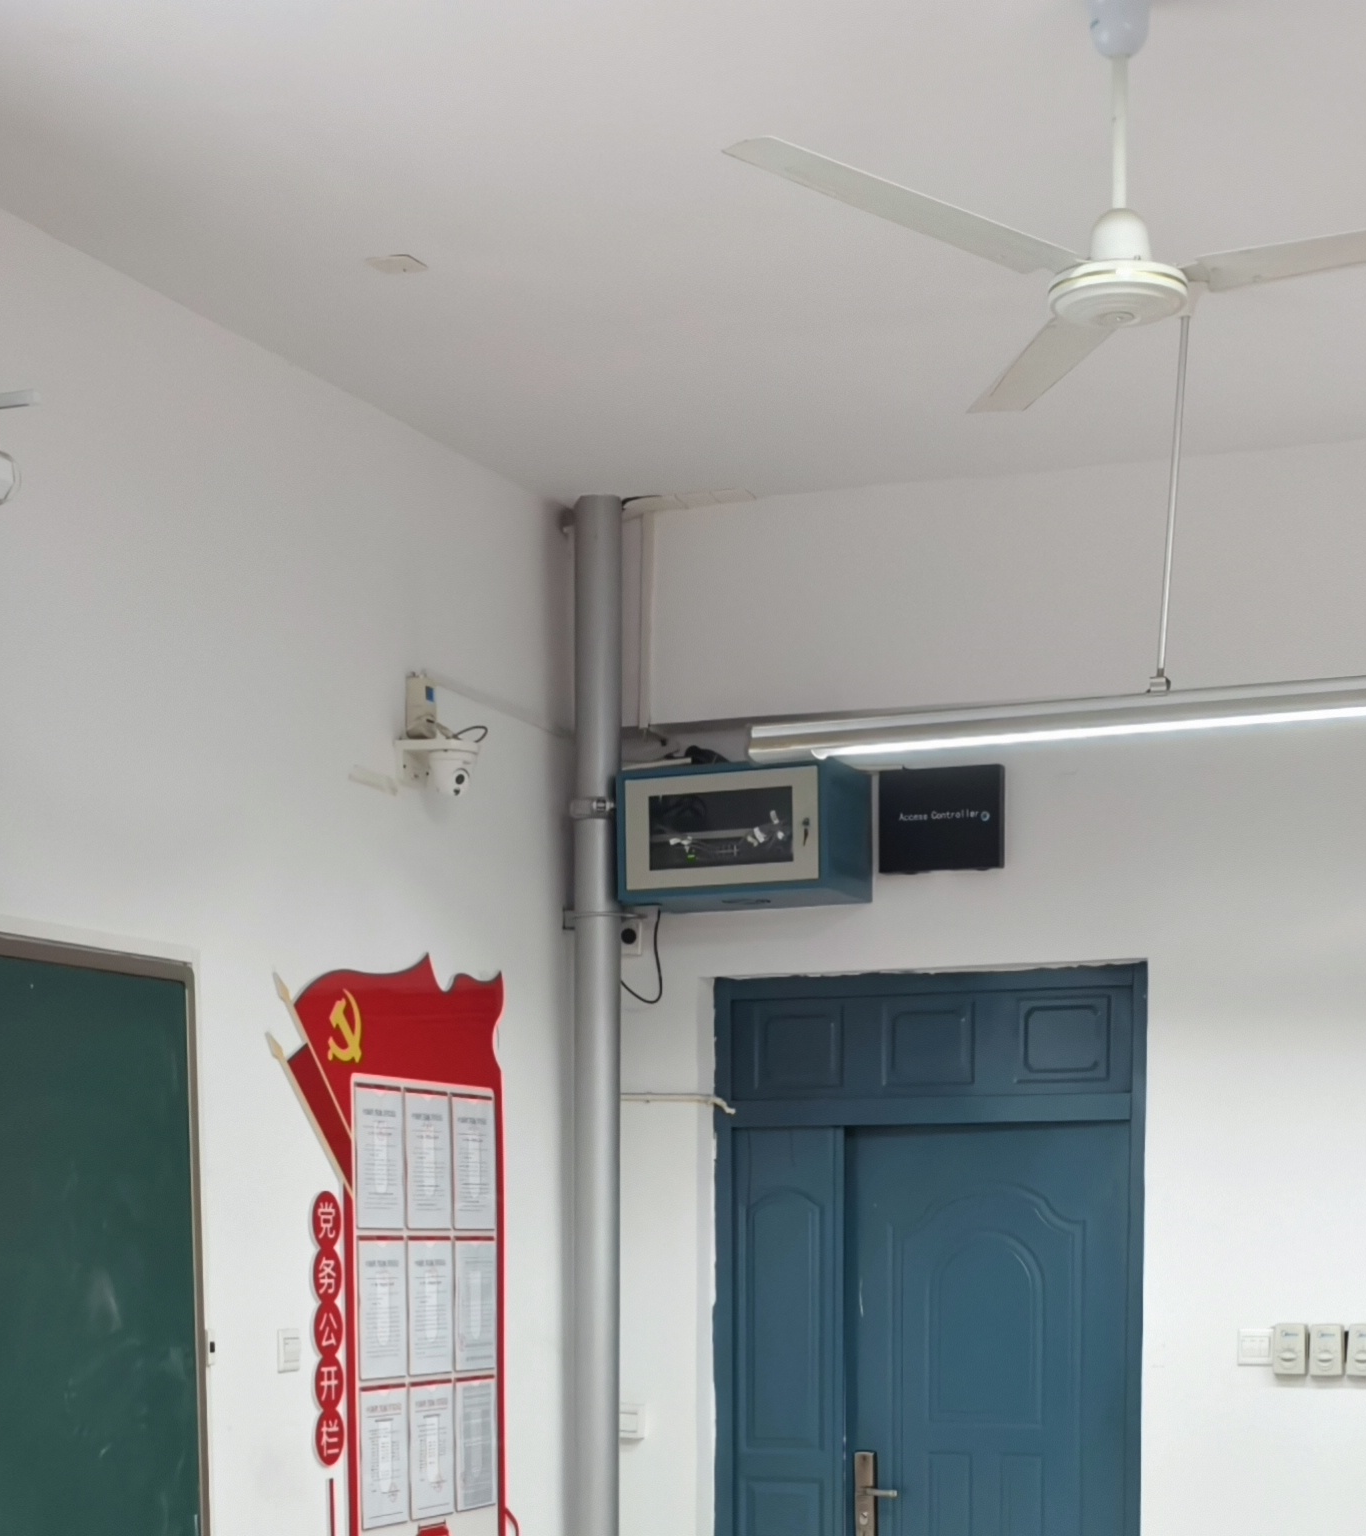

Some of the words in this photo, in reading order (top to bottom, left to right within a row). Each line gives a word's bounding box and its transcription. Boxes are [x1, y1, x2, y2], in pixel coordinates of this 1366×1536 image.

[899, 812, 928, 821] Access
[931, 808, 979, 820] Controller
[317, 1201, 340, 1457] 党务公开栏
